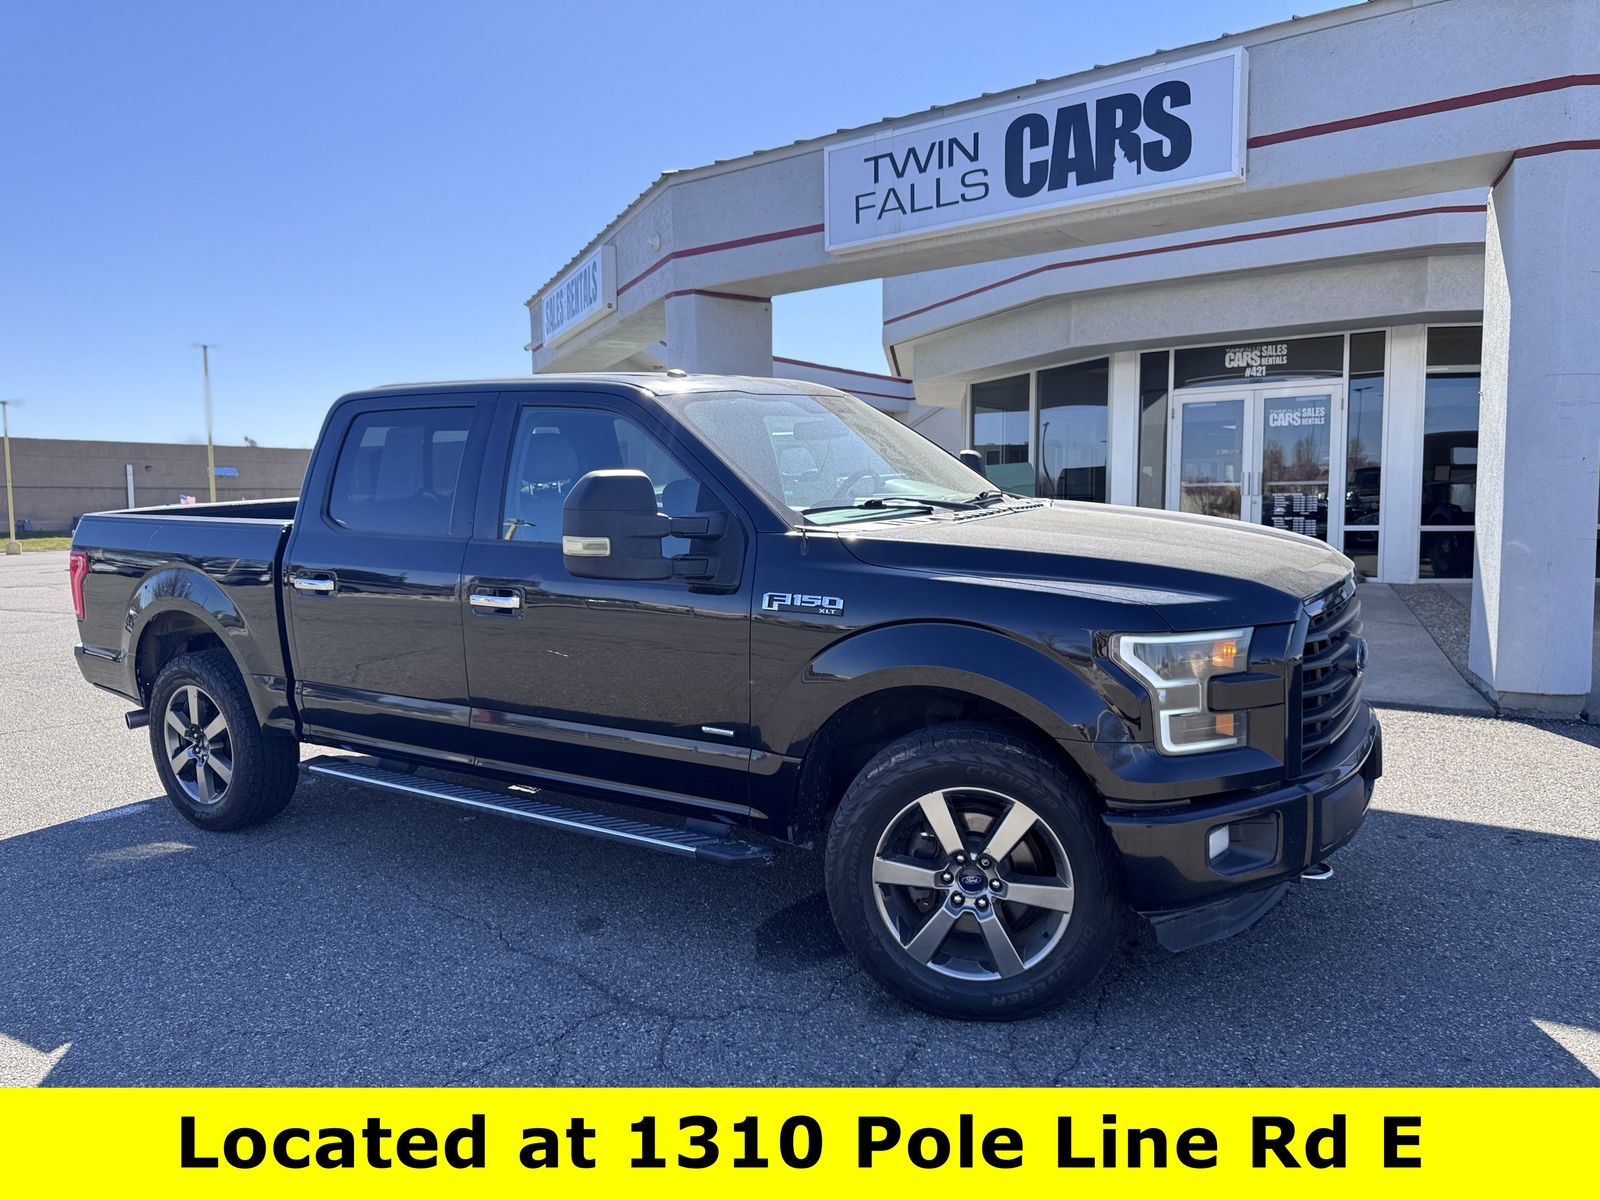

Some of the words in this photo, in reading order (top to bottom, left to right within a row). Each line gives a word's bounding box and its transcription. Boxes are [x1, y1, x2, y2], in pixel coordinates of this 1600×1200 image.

[1004, 80, 1193, 198] CARS
[863, 131, 980, 184] TWIN
[855, 168, 990, 225] FALLS
[1261, 343, 1288, 356] SALES
[1224, 351, 1261, 369] CARS
[1261, 355, 1288, 366] RENTALS
[1244, 365, 1267, 378] #421
[1269, 412, 1301, 427] CARS
[1302, 406, 1326, 418] SALES
